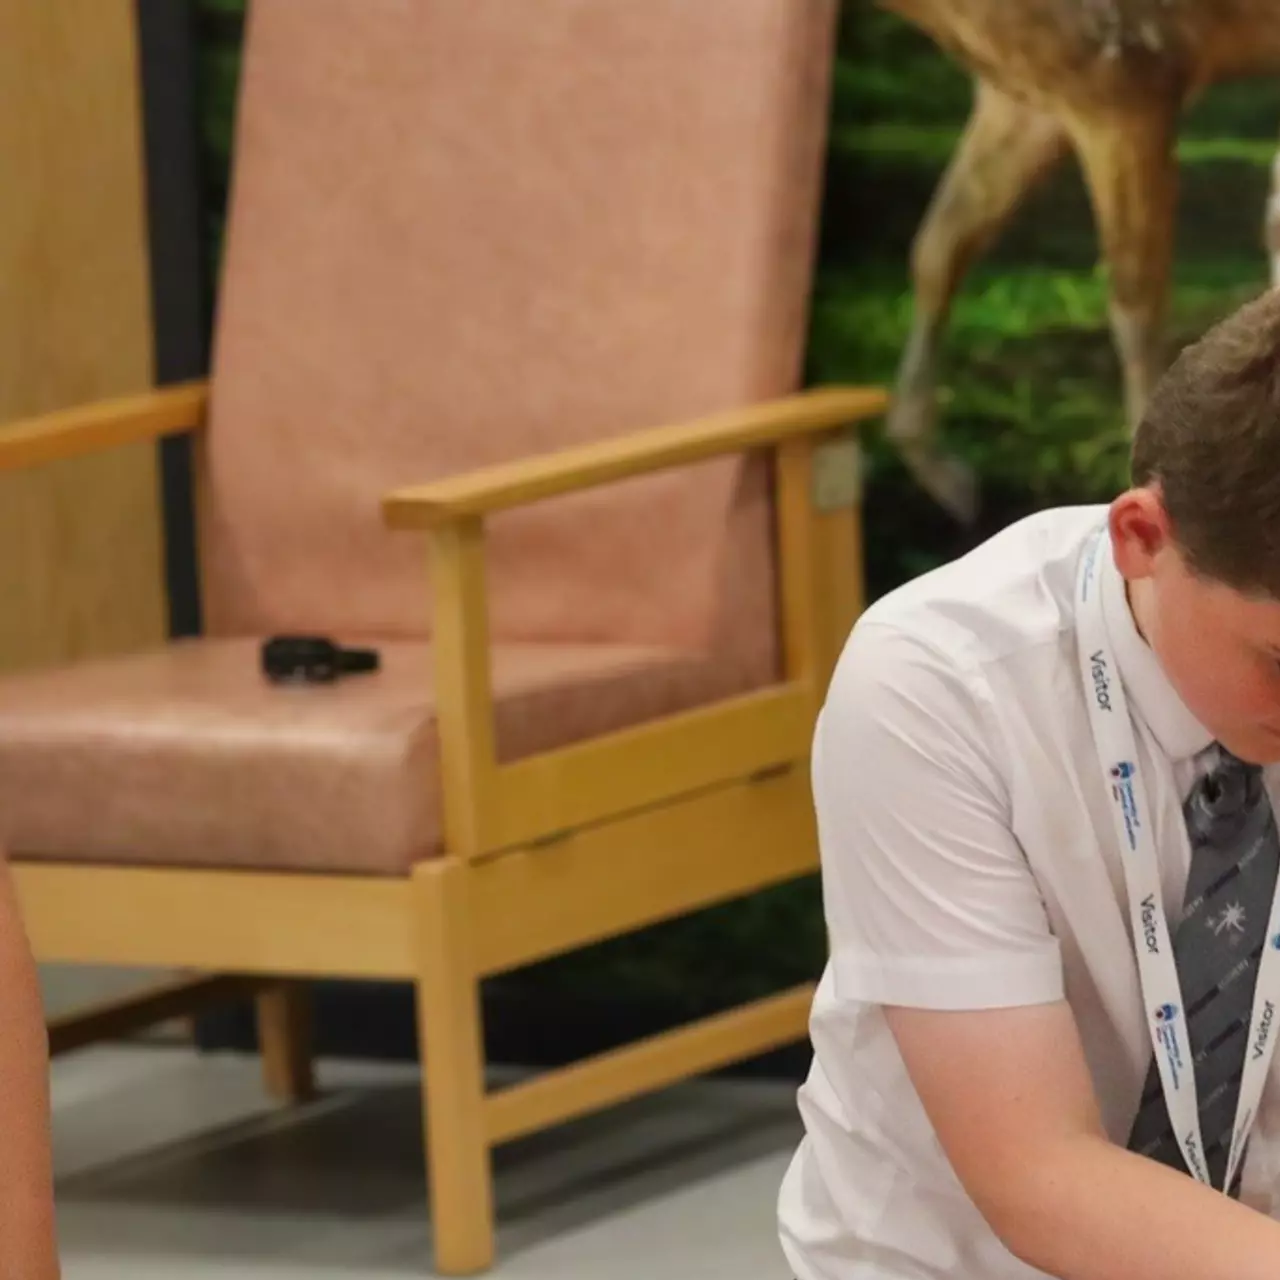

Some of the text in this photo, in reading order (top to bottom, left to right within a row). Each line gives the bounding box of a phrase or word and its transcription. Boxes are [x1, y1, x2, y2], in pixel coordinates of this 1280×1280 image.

[1090, 649, 1112, 712] Visitor
[1140, 893, 1160, 954] Visitor
[1252, 999, 1275, 1060] Visitor
[1185, 1130, 1205, 1183] Visito
